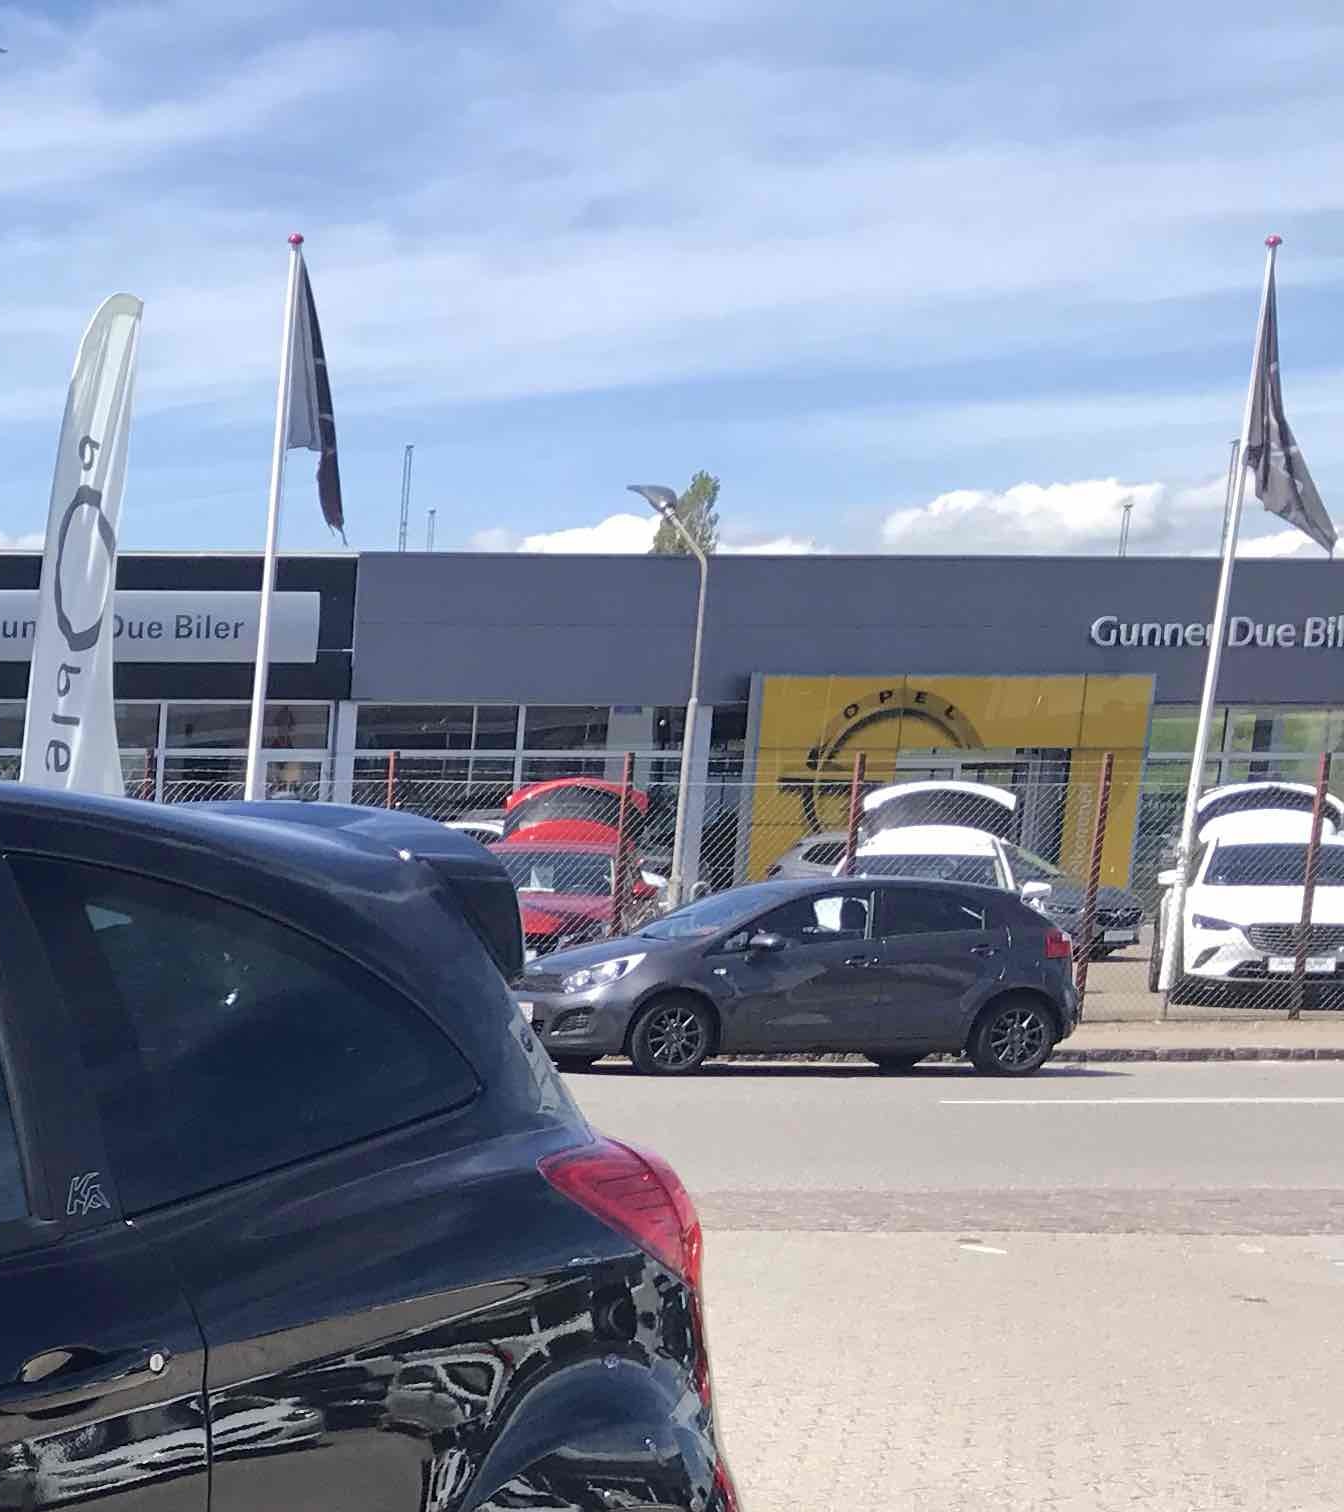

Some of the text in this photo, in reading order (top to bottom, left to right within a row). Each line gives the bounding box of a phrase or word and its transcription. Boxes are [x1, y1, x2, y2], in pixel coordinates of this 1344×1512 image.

[175, 614, 245, 639] Biler
[1228, 616, 1296, 647] Due
[843, 690, 959, 720] OPEL
